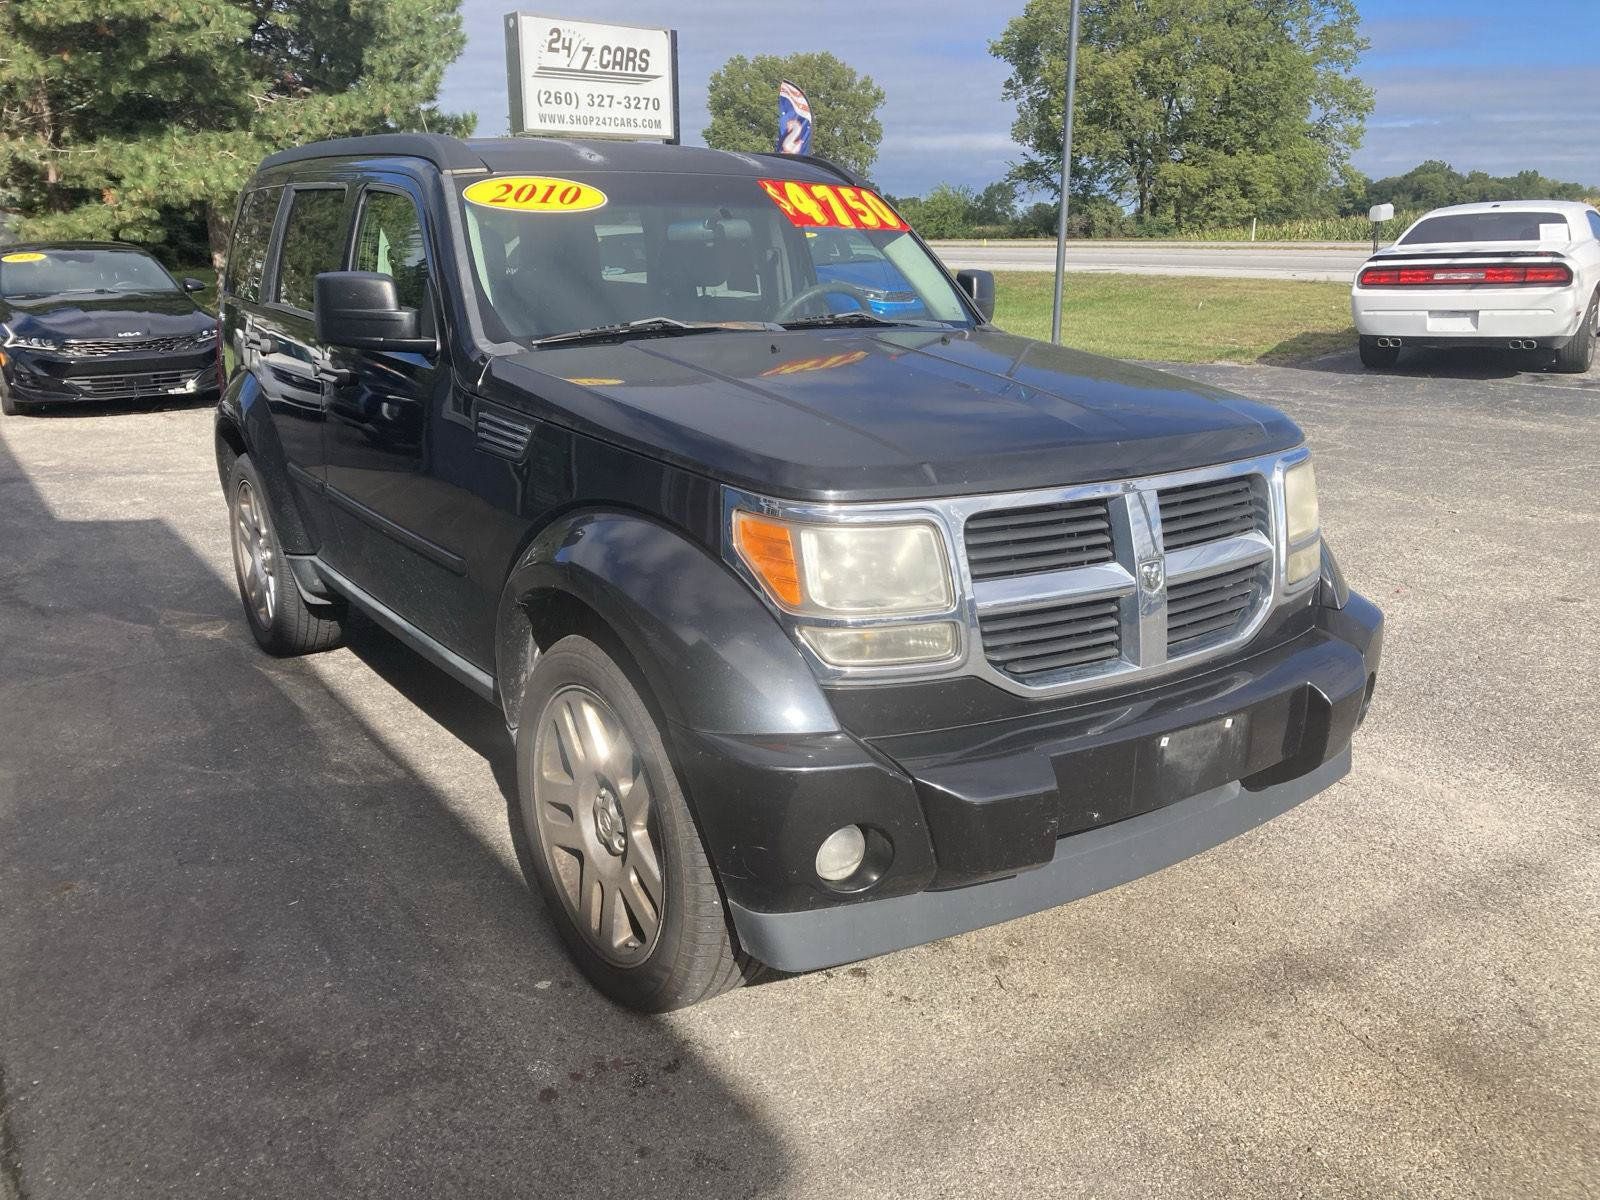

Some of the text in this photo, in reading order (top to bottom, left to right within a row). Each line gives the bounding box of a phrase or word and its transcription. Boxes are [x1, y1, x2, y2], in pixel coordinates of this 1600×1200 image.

[547, 27, 651, 73] 24/7 CARS
[537, 90, 661, 111] (260) 327-3270
[538, 113, 662, 129] WWW.SHOP247CARS.COM
[489, 183, 582, 206] 2010
[763, 180, 901, 228] $4750
